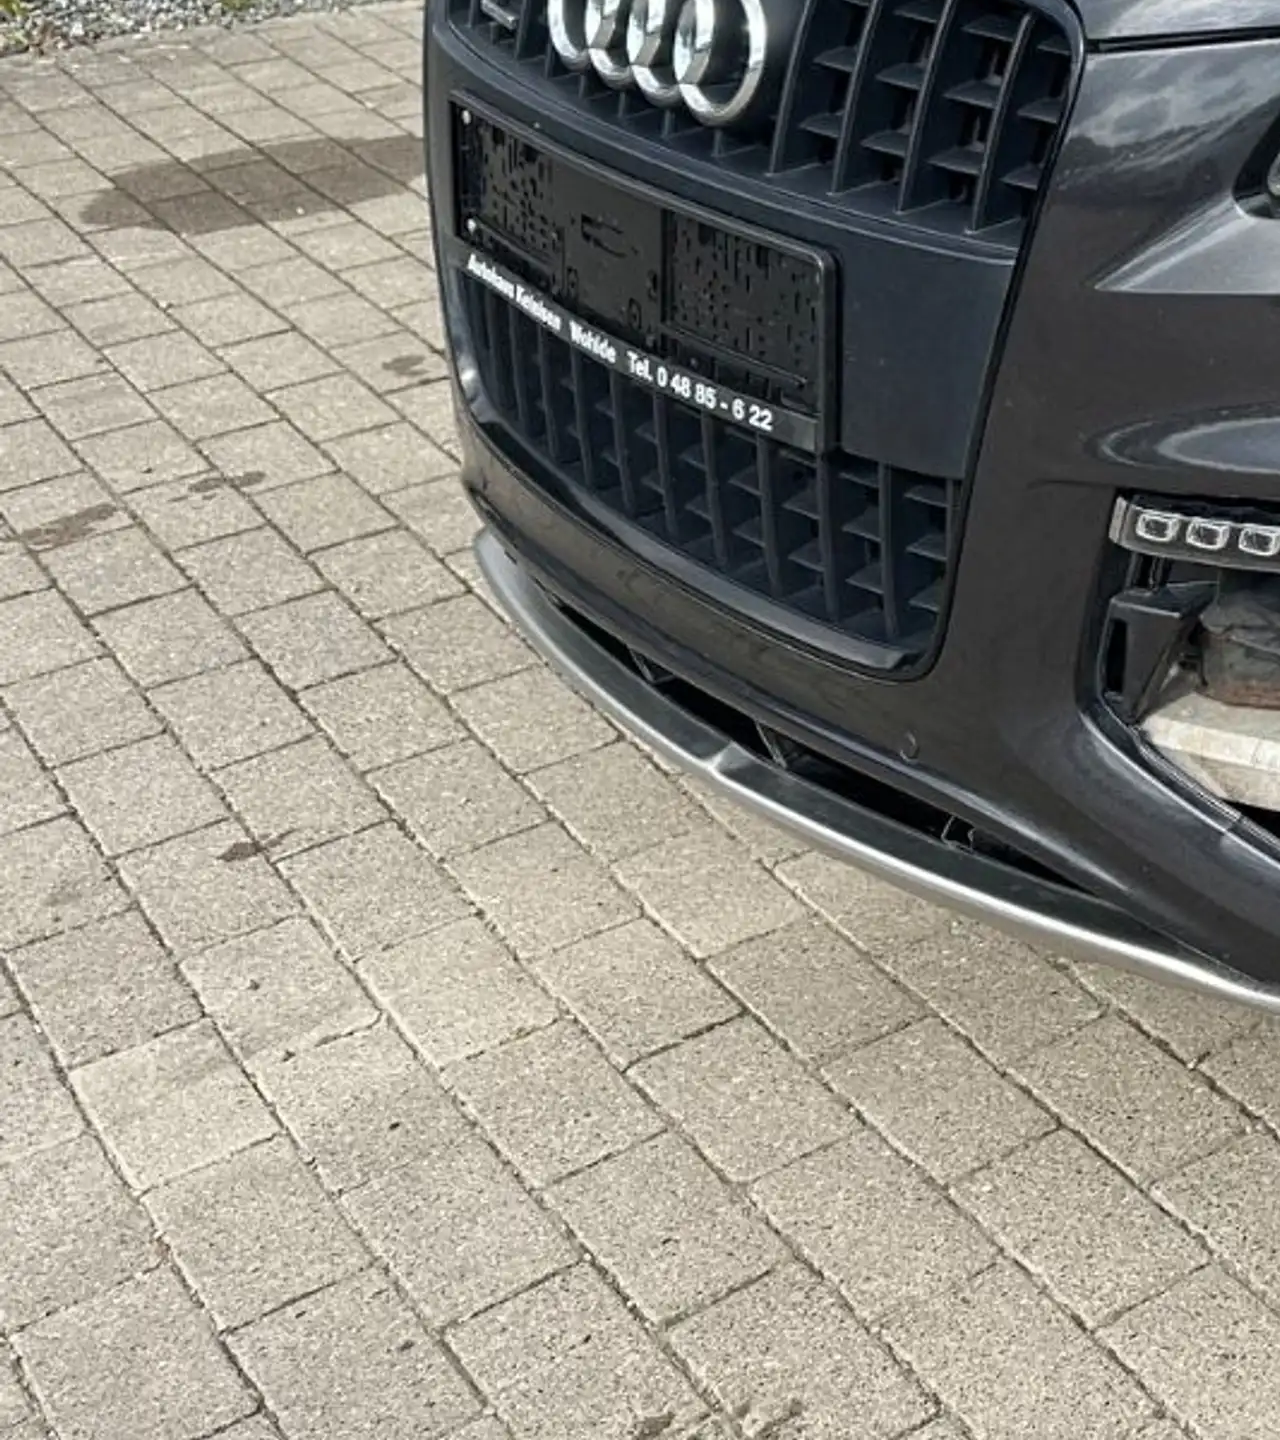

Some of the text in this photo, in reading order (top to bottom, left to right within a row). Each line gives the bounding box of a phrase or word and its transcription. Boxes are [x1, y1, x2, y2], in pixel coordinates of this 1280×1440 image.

[656, 366, 668, 388] 0
[670, 373, 692, 398] 48
[694, 382, 717, 410] 85
[731, 398, 746, 421] 6
[748, 405, 774, 433] 22
